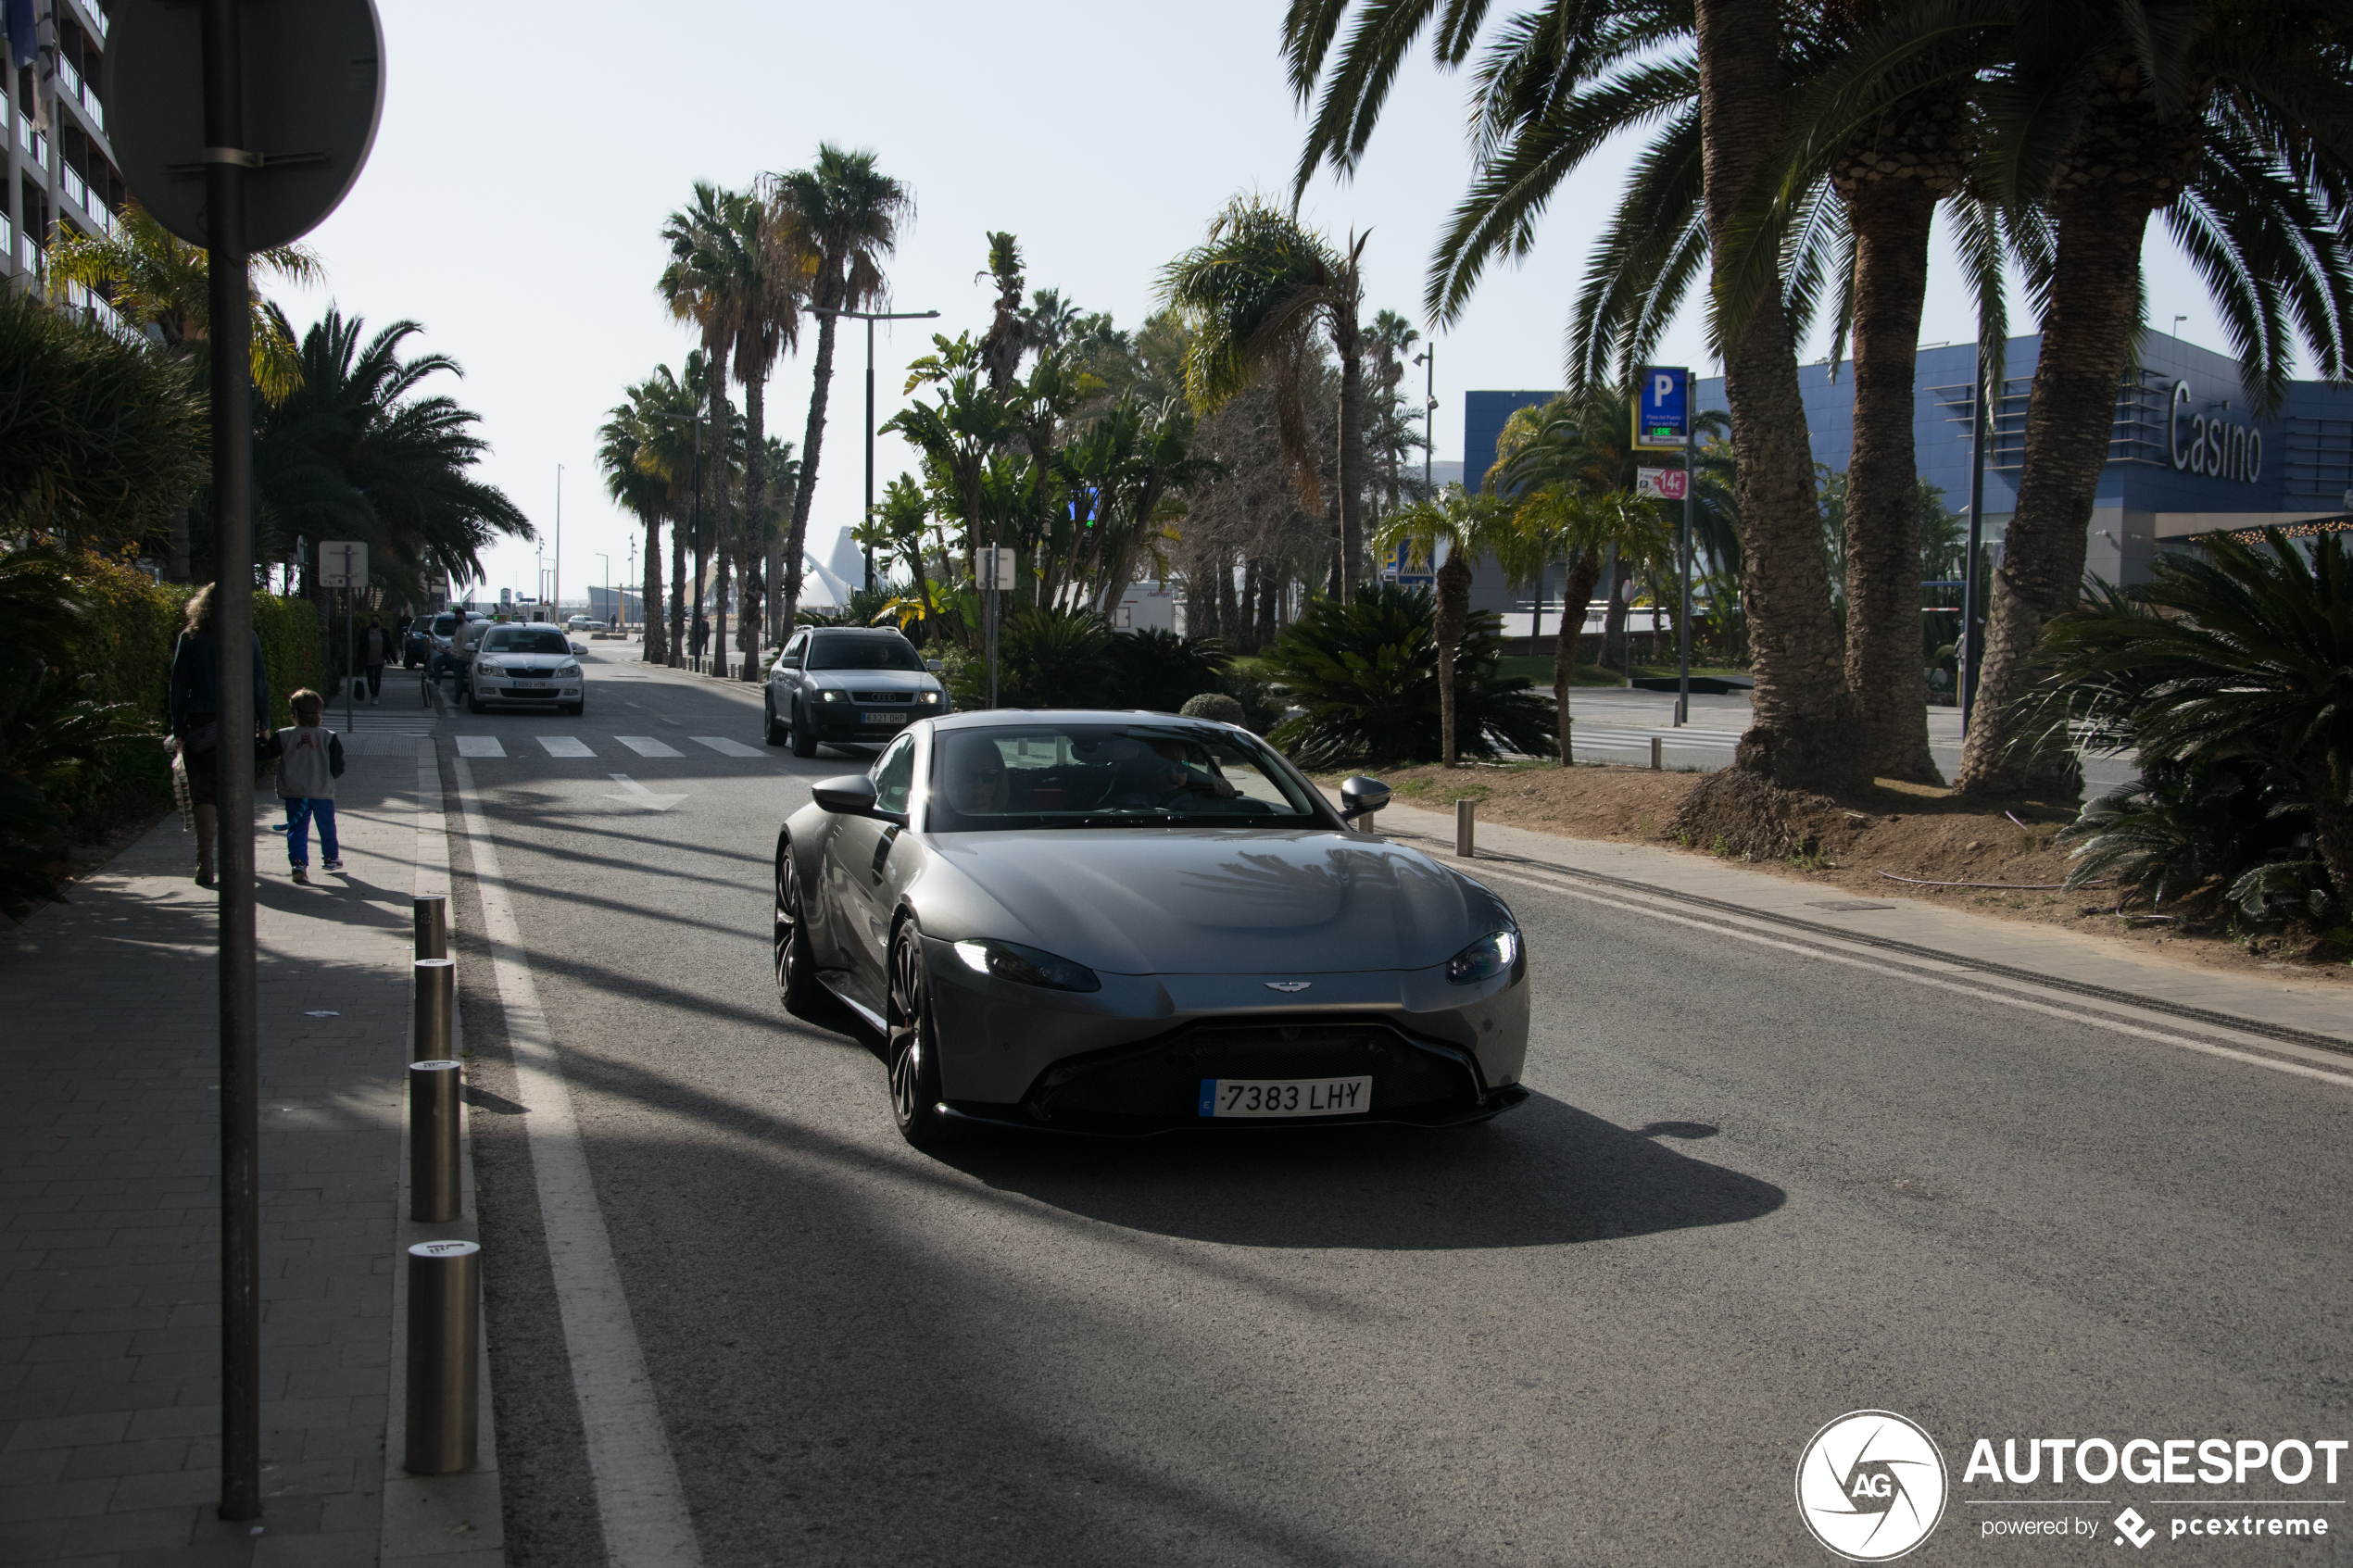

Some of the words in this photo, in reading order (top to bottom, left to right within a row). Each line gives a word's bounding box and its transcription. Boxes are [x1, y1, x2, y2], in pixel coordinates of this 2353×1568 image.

[1655, 374, 1674, 408] P
[2170, 380, 2260, 483] Casino
[867, 714, 887, 722] 6321
[889, 714, 905, 722] DHP
[1227, 1085, 1300, 1111] 7383
[1309, 1082, 1362, 1110] LHY
